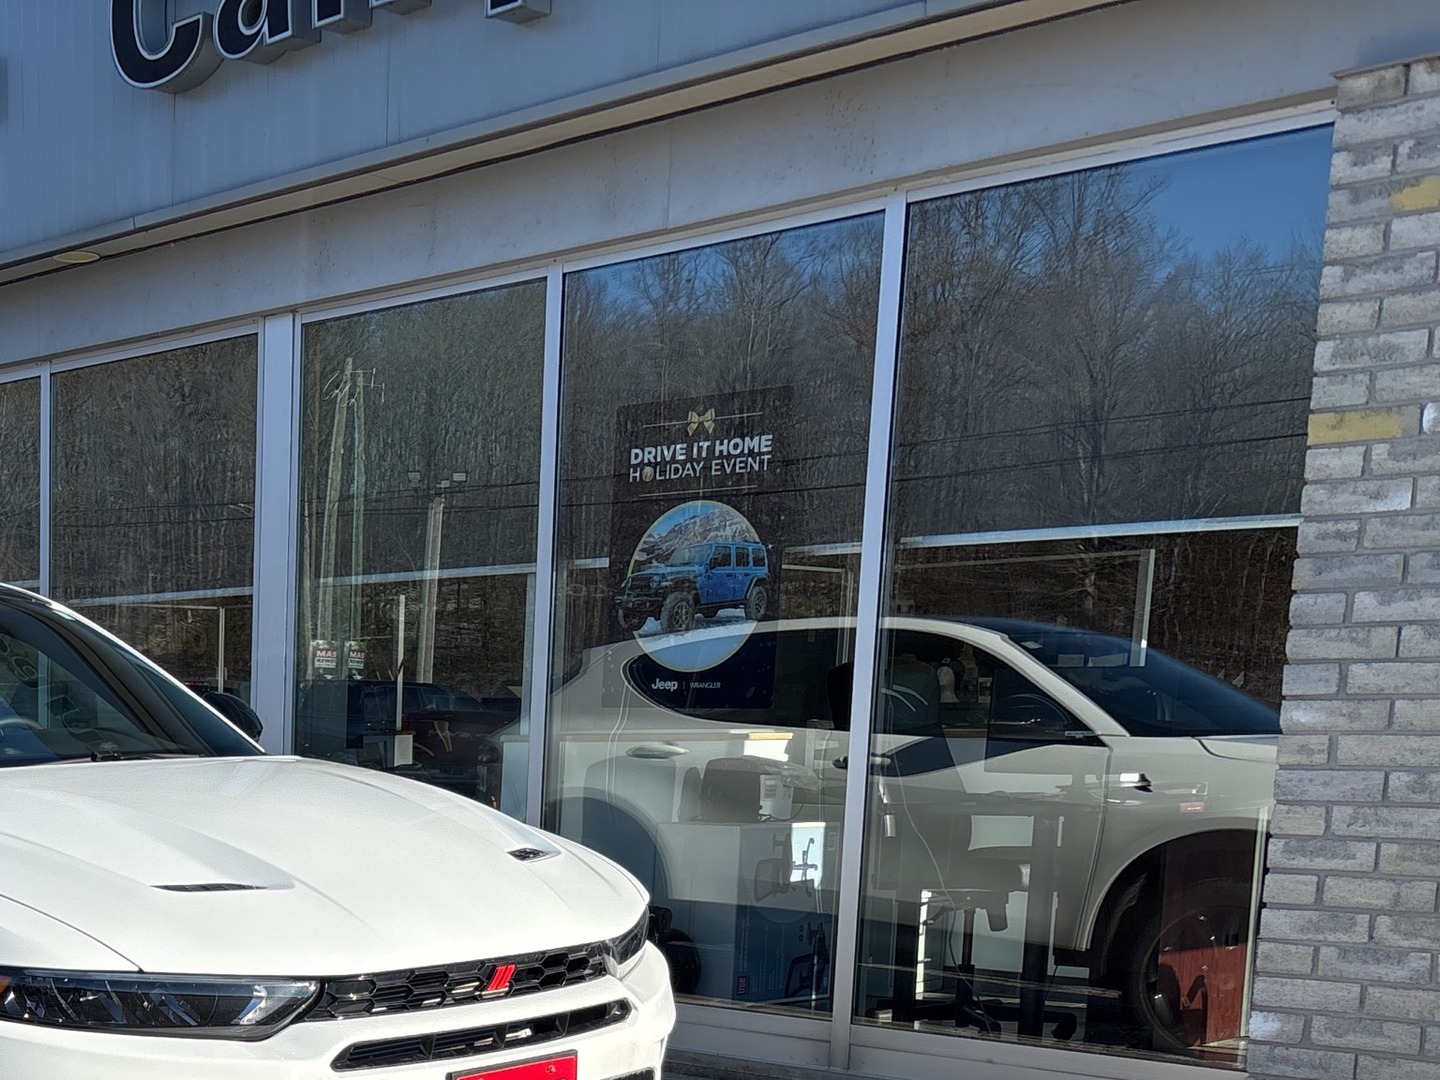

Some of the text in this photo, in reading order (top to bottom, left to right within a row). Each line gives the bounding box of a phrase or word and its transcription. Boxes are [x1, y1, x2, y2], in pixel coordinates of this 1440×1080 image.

[630, 434, 773, 465] DRIVE IT HOME
[629, 455, 772, 483] HOLIDAY EVENT
[651, 678, 721, 692] Jeep WRANGLER
